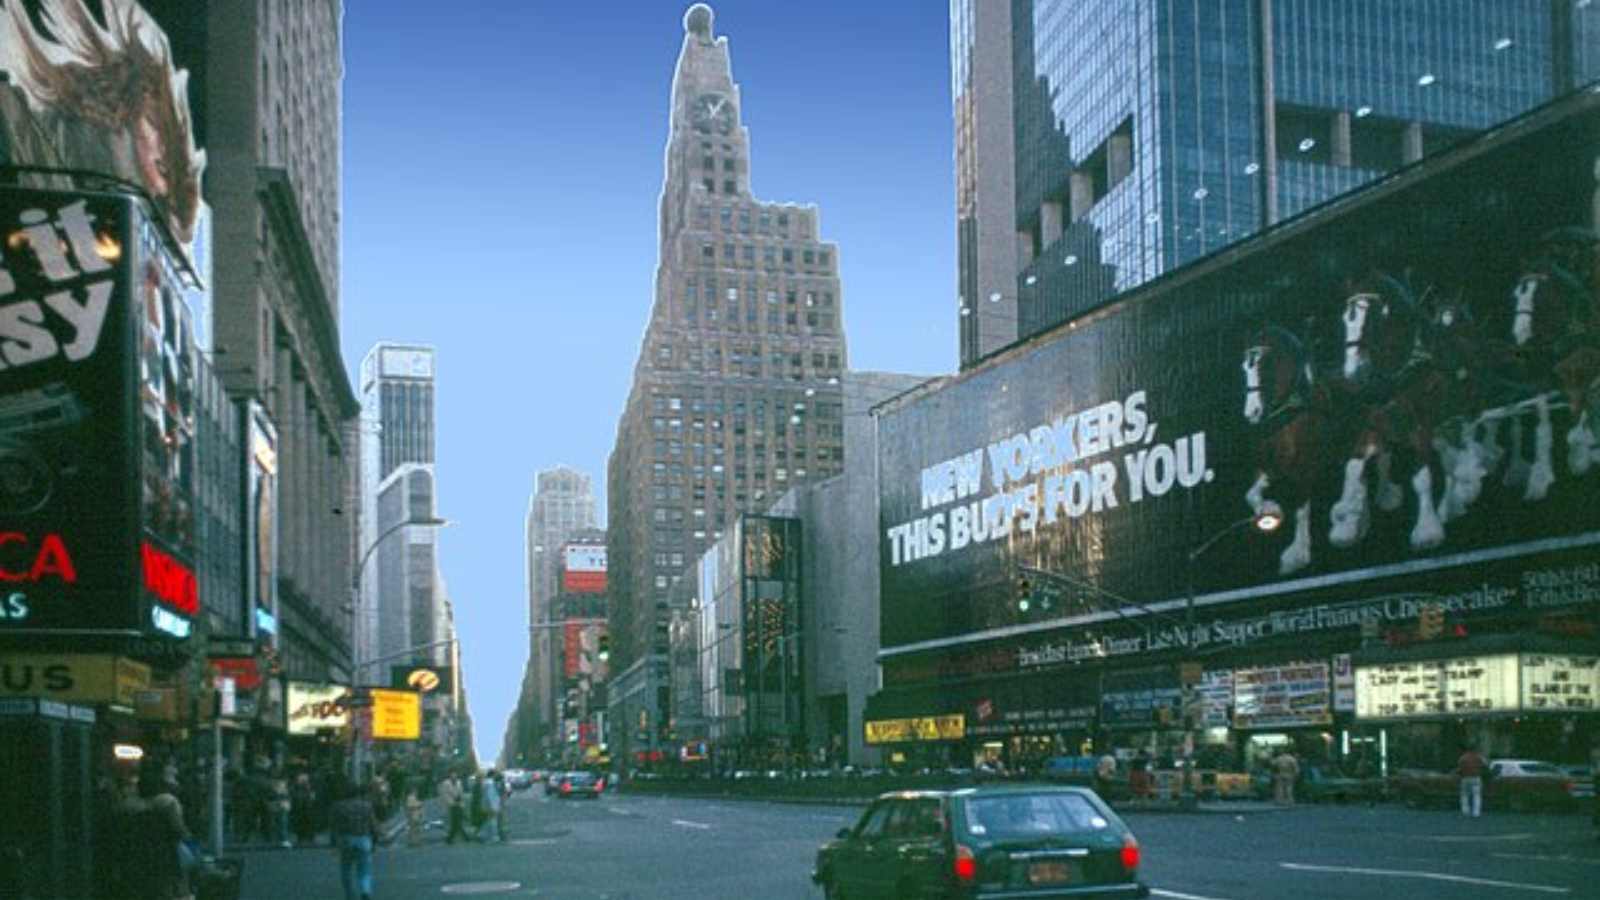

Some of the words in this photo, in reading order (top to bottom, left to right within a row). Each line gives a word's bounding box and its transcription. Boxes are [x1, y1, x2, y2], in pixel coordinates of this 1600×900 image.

[19, 199, 114, 282] it
[0, 281, 114, 368] sy
[887, 512, 946, 565] THIS
[1041, 460, 1118, 524] FOR
[1124, 431, 1214, 502] YOU.
[921, 448, 983, 510] NEW
[987, 390, 1157, 488] YORKERS,
